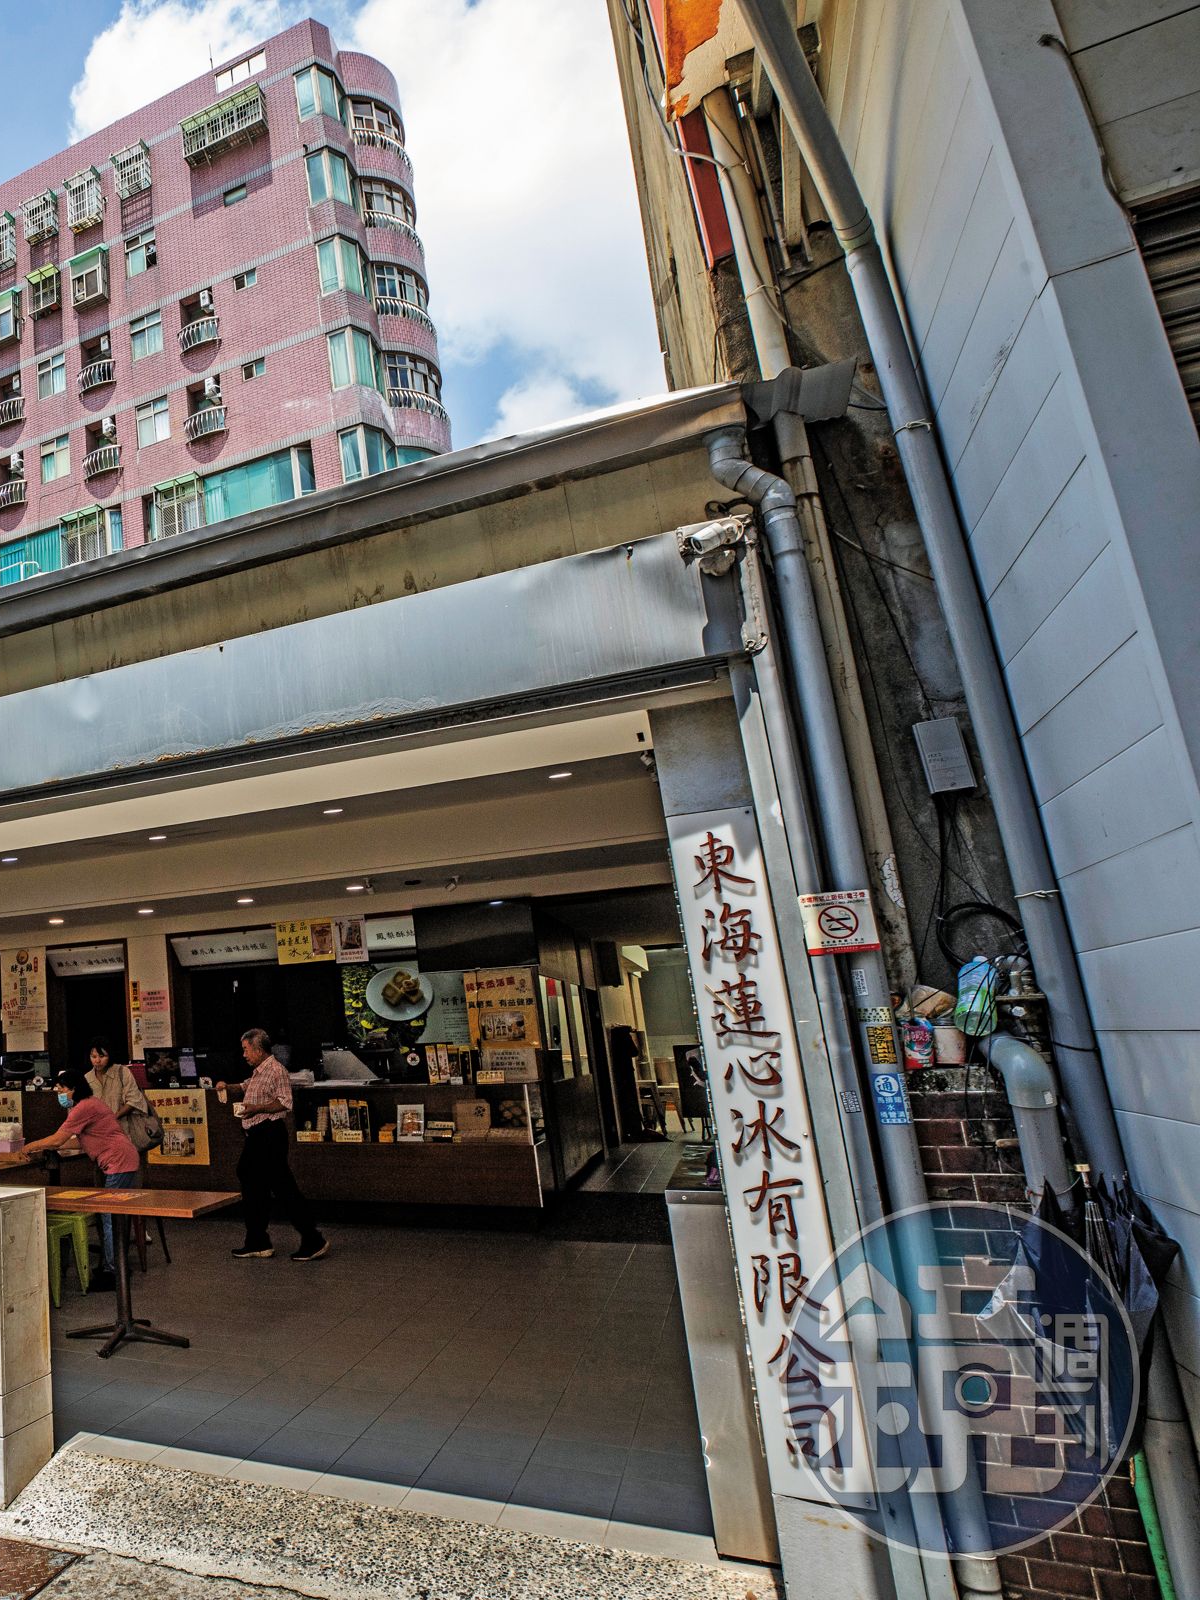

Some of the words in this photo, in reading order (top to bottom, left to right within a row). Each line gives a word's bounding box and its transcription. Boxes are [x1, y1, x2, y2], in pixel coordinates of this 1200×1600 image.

[693, 831, 843, 1476] 東海蓮心冰有限公司
